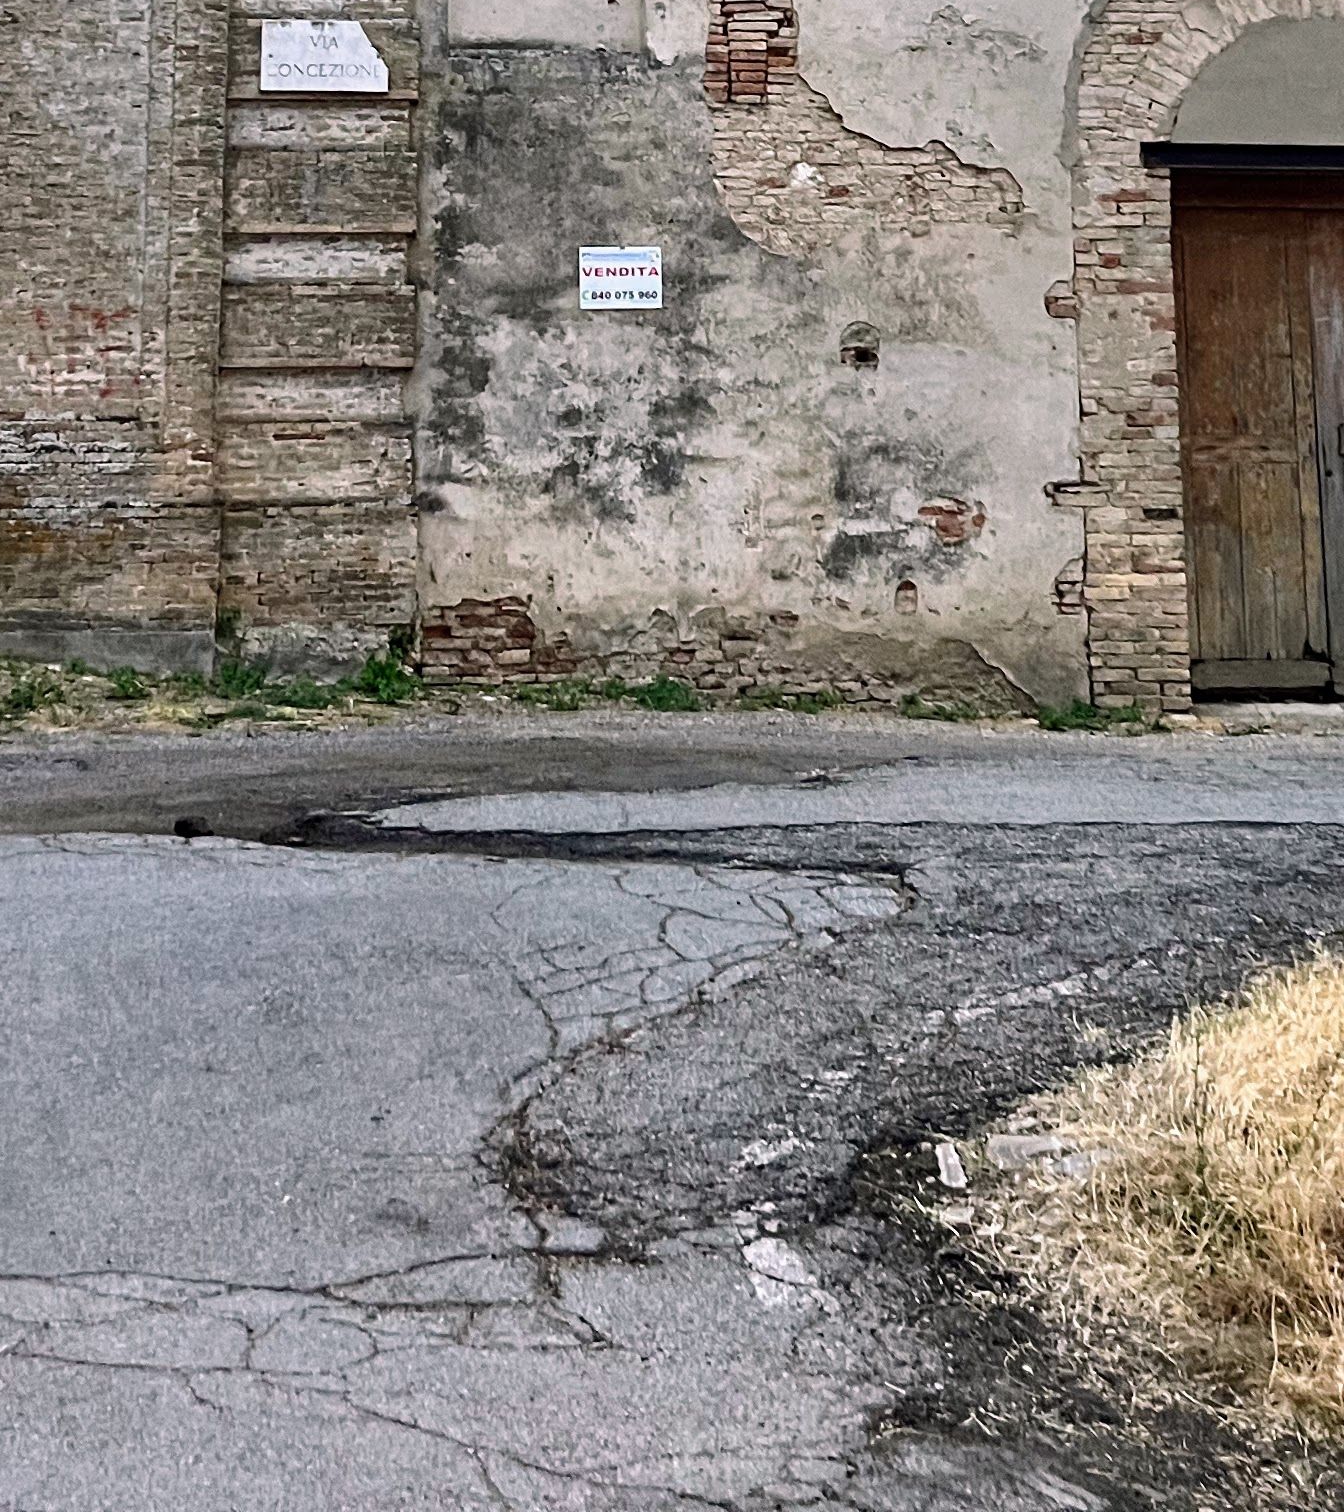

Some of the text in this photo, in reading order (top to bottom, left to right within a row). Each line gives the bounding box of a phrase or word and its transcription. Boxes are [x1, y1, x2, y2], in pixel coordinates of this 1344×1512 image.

[310, 35, 339, 49] VIA
[267, 63, 380, 78] CONCEZIONE
[582, 267, 659, 277] VENDITA
[591, 290, 611, 300] 840
[638, 290, 658, 300] 960
